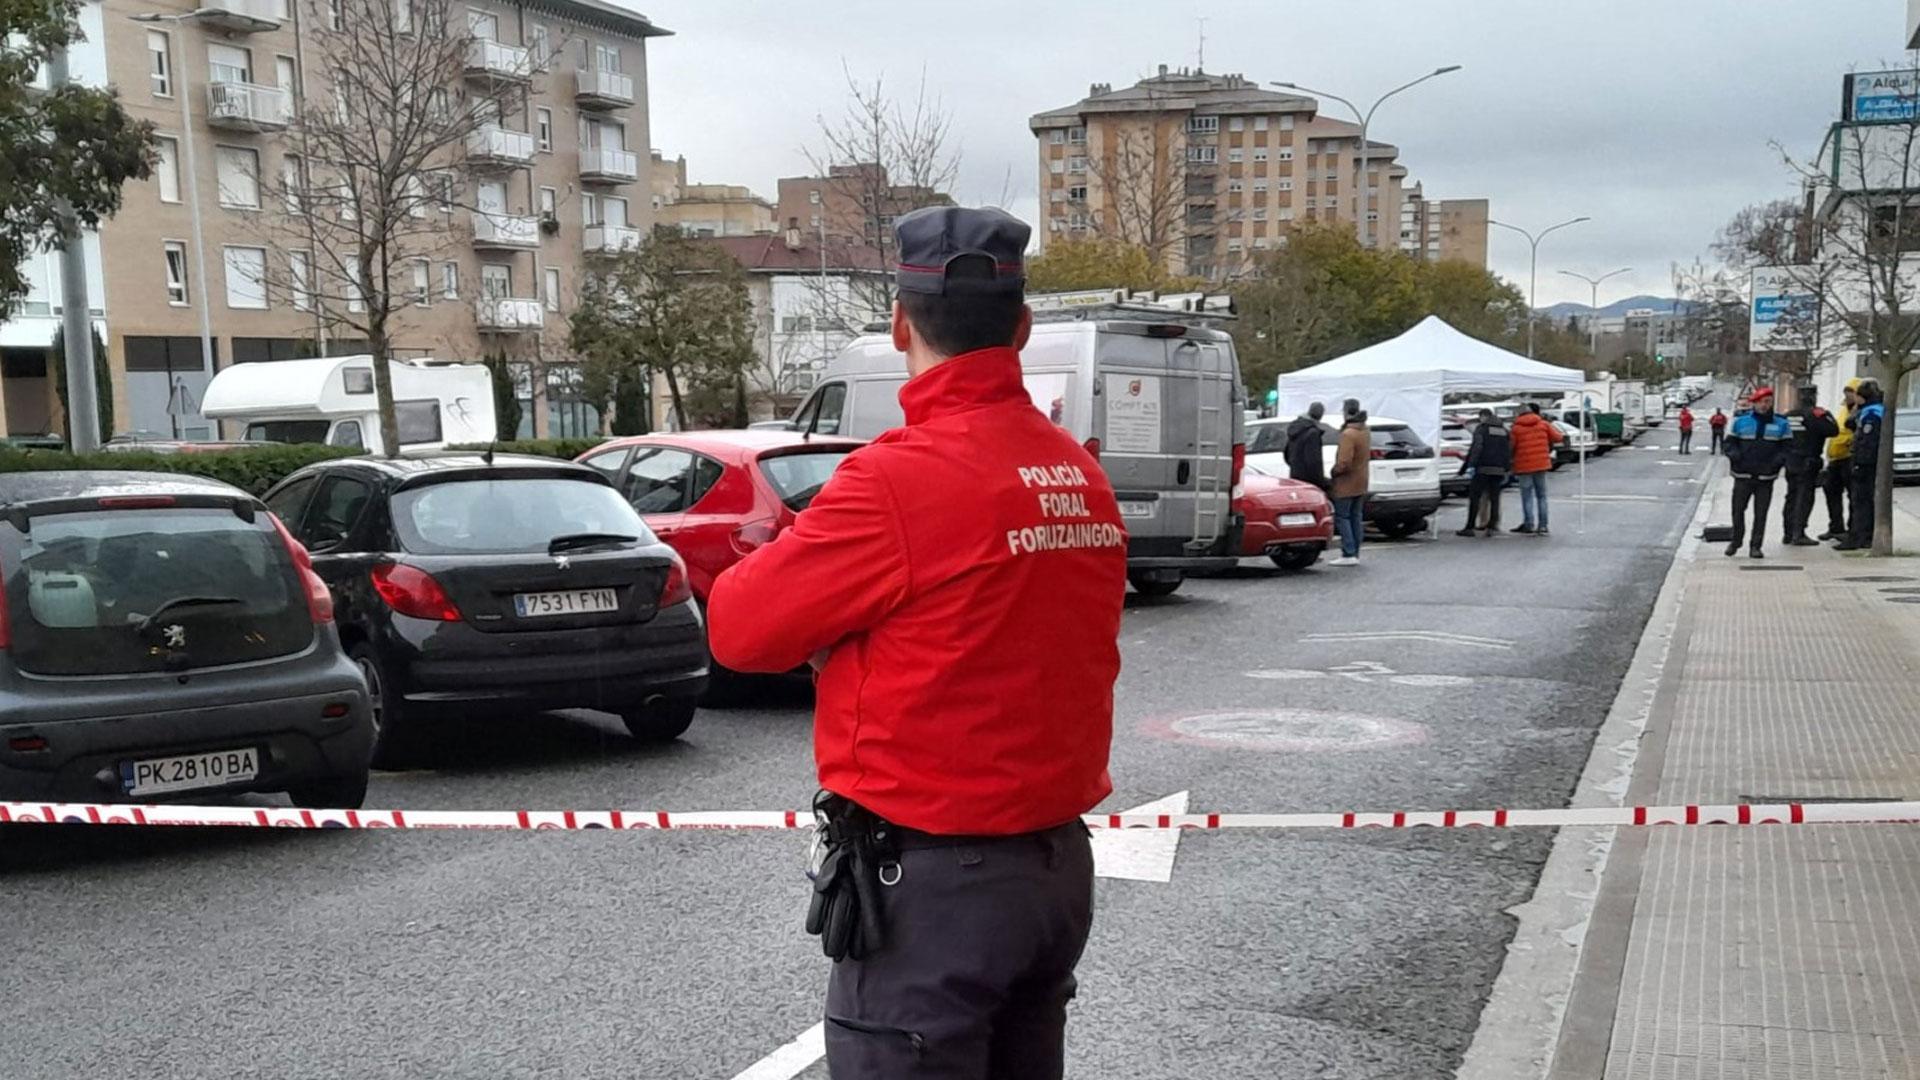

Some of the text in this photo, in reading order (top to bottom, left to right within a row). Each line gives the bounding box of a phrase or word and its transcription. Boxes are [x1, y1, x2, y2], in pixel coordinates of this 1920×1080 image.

[1038, 493, 1091, 518] FORAL
[528, 590, 614, 614] 7531 FYN
